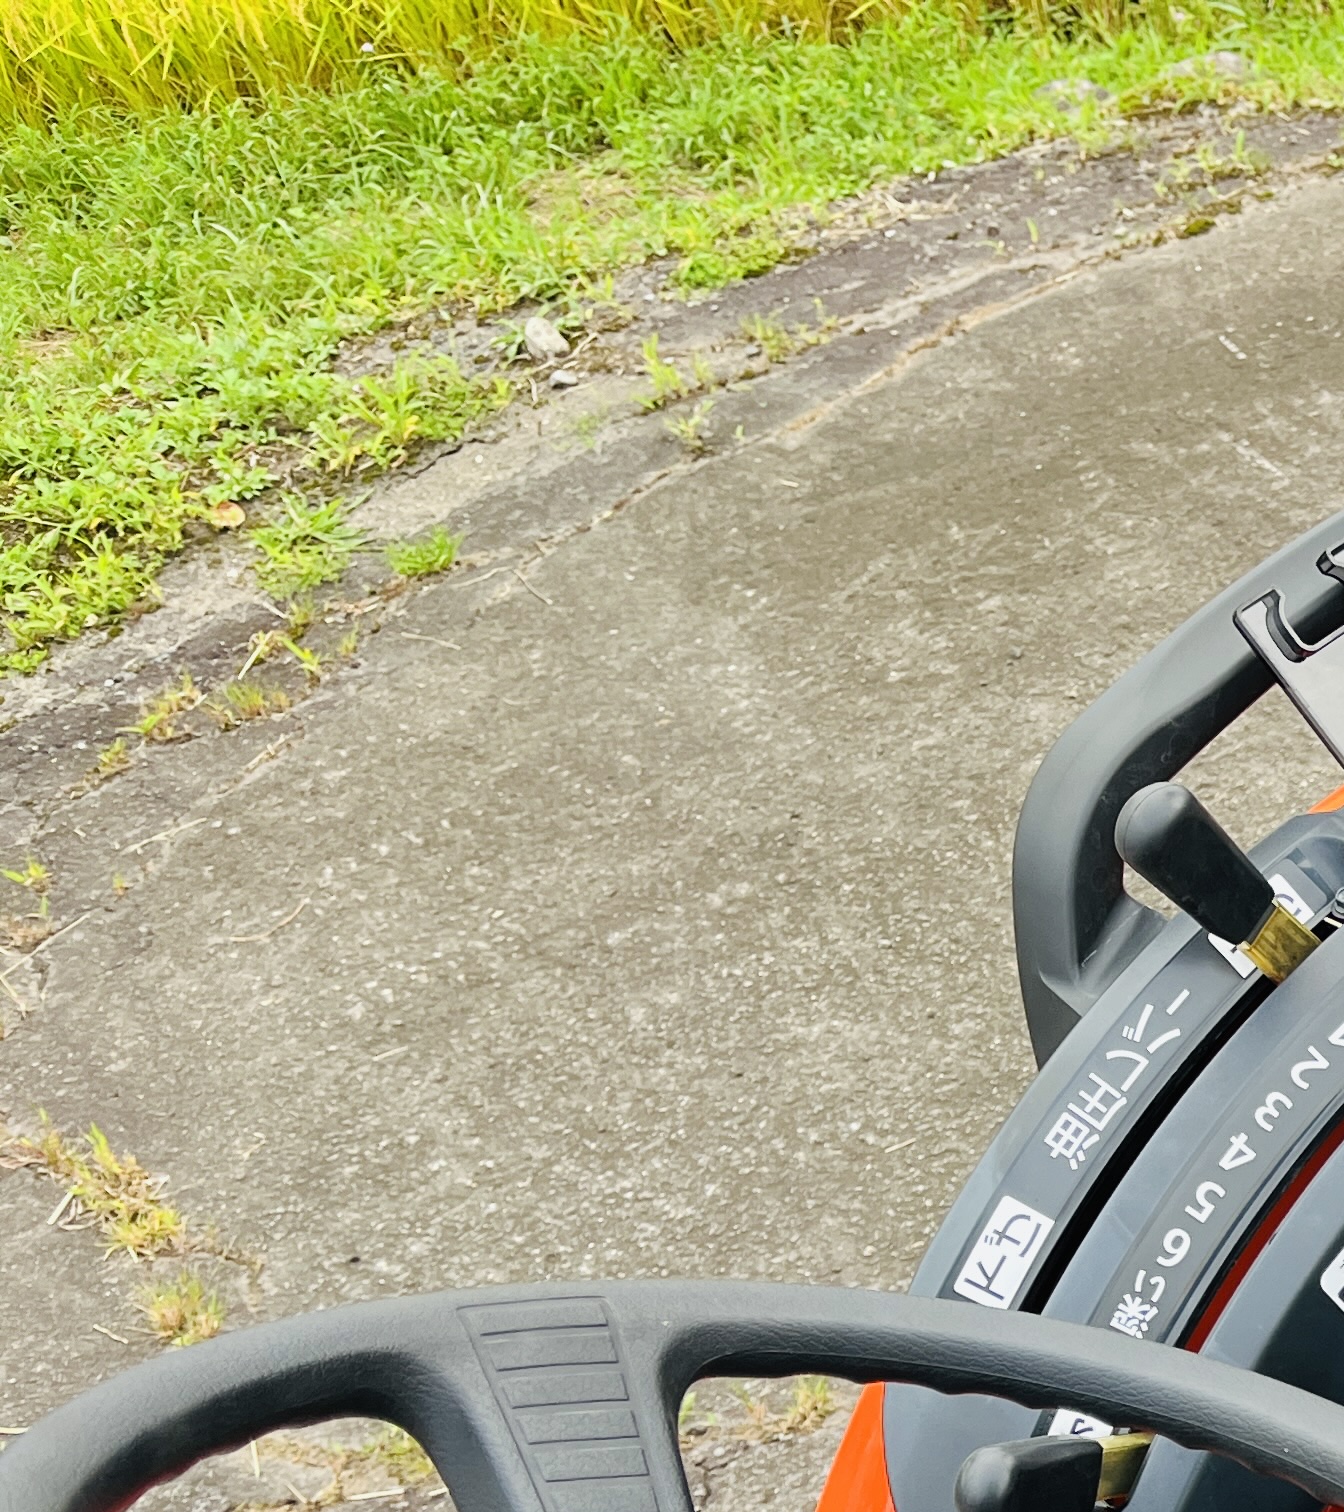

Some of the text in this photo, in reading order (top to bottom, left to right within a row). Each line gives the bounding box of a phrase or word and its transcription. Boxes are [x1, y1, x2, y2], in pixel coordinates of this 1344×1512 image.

[1044, 989, 1190, 1171] 油圧レバー
[1290, 1045, 1330, 1091] 2
[1253, 1089, 1294, 1135] 3
[1218, 1131, 1257, 1174] 4
[1184, 1179, 1227, 1224] 5
[964, 1214, 1042, 1301] 下げ
[1110, 1269, 1166, 1339] 深い
